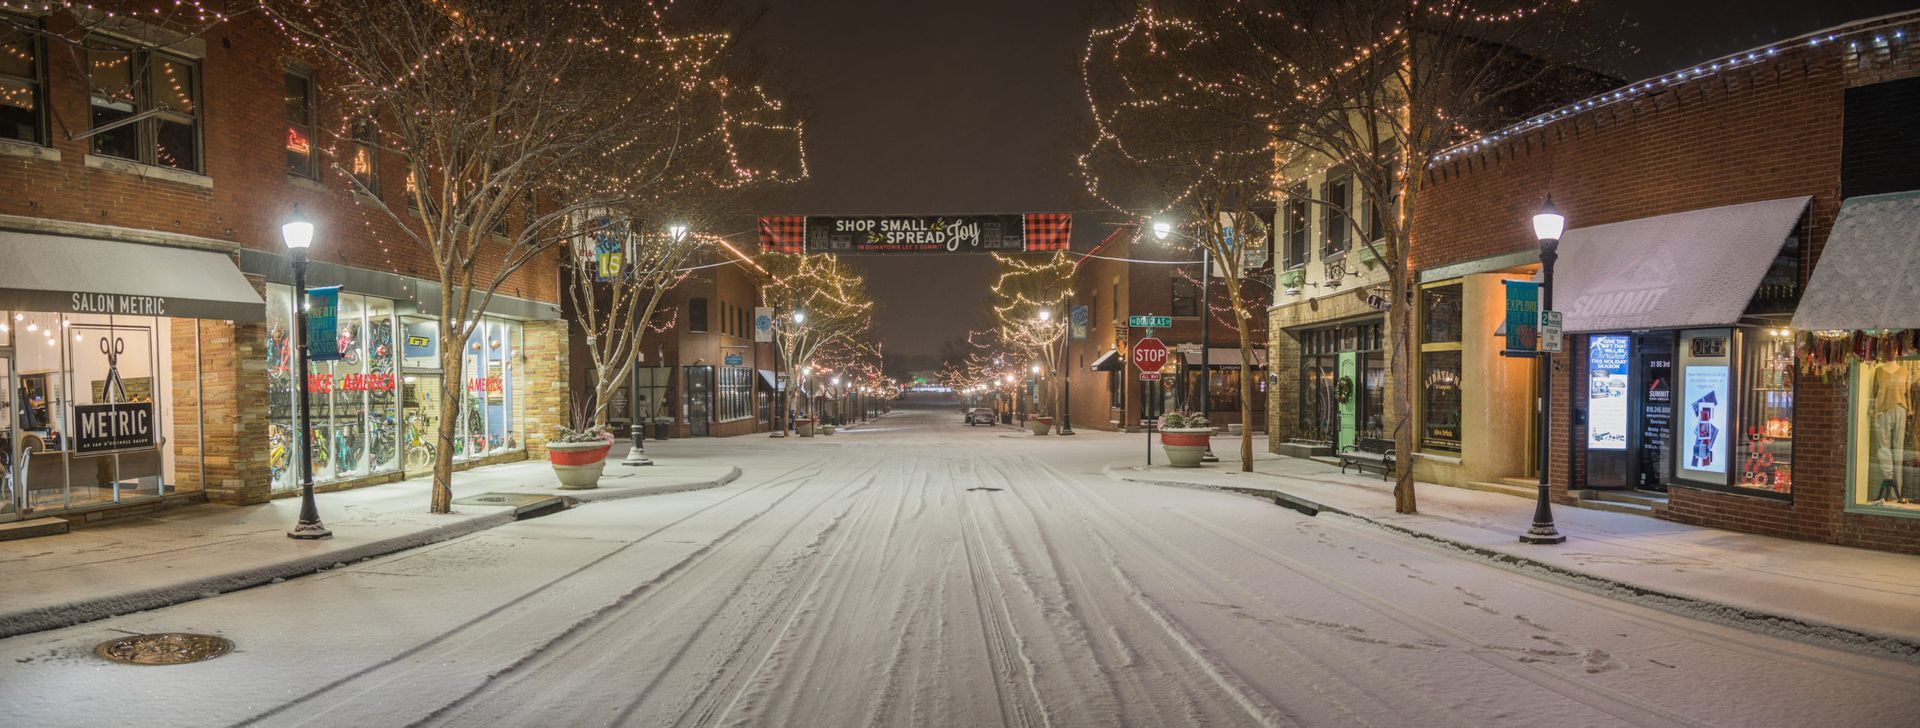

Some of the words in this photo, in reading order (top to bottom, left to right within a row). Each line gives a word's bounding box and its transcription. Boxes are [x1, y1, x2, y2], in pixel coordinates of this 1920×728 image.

[836, 220, 876, 231] SHOP
[880, 219, 928, 231] SMALL
[886, 231, 945, 244] SPREAD
[946, 219, 981, 252] Joy
[72, 292, 114, 312] SALON
[120, 295, 165, 315] METRIC
[1567, 287, 1671, 317] SUMMIT
[1136, 317, 1166, 326] DOUGLAS
[1542, 313, 1548, 324] 2
[408, 336, 430, 347] GT
[1136, 349, 1165, 362] STOP
[343, 373, 396, 391] AMERICA
[81, 409, 147, 439] METRIC
